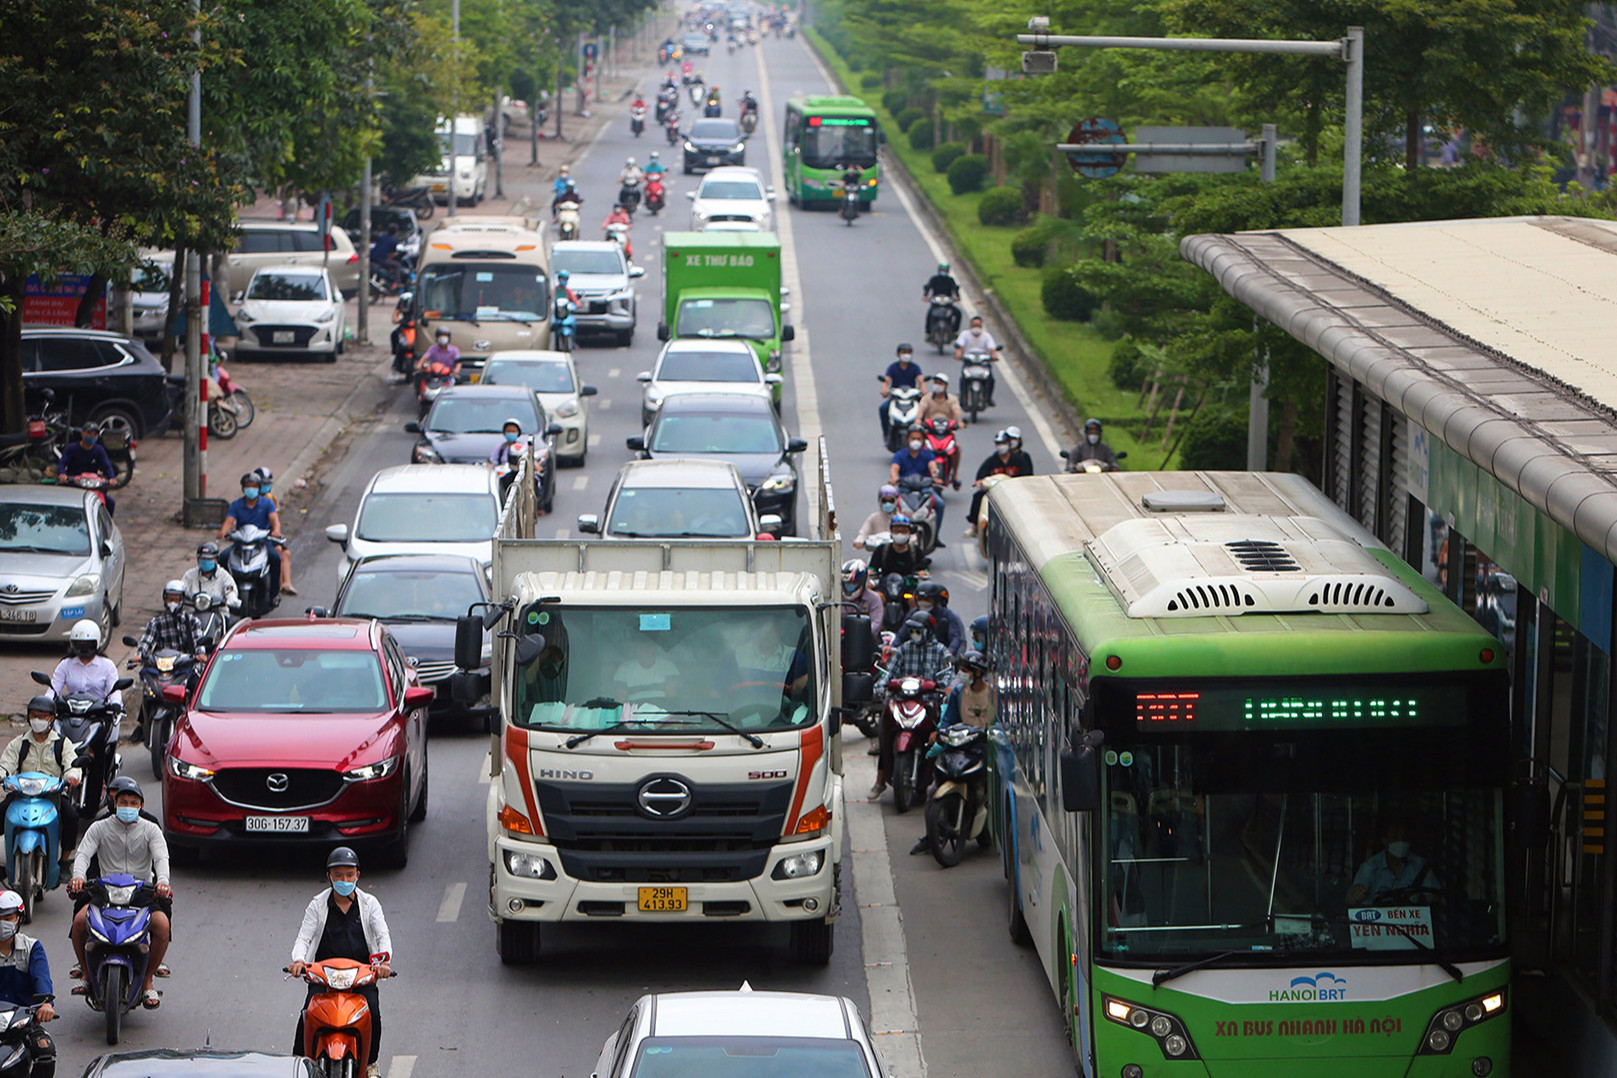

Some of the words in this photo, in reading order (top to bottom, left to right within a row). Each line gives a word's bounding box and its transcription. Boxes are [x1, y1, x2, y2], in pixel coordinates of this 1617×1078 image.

[686, 255, 701, 266] XE
[704, 254, 728, 266] THƯ
[729, 252, 754, 266] BÁO
[540, 769, 594, 780] HINO
[748, 770, 788, 780] 500
[247, 817, 308, 831] 30G-157.37
[652, 887, 674, 899] 29H
[643, 898, 682, 910] 413.93
[1360, 910, 1377, 920] BRT
[1408, 909, 1422, 919] XE
[1243, 1020, 1274, 1036] BUS
[1278, 1018, 1338, 1036] NHANH
[1342, 1015, 1366, 1034] HÀ
[1369, 1014, 1402, 1037] NỘI
